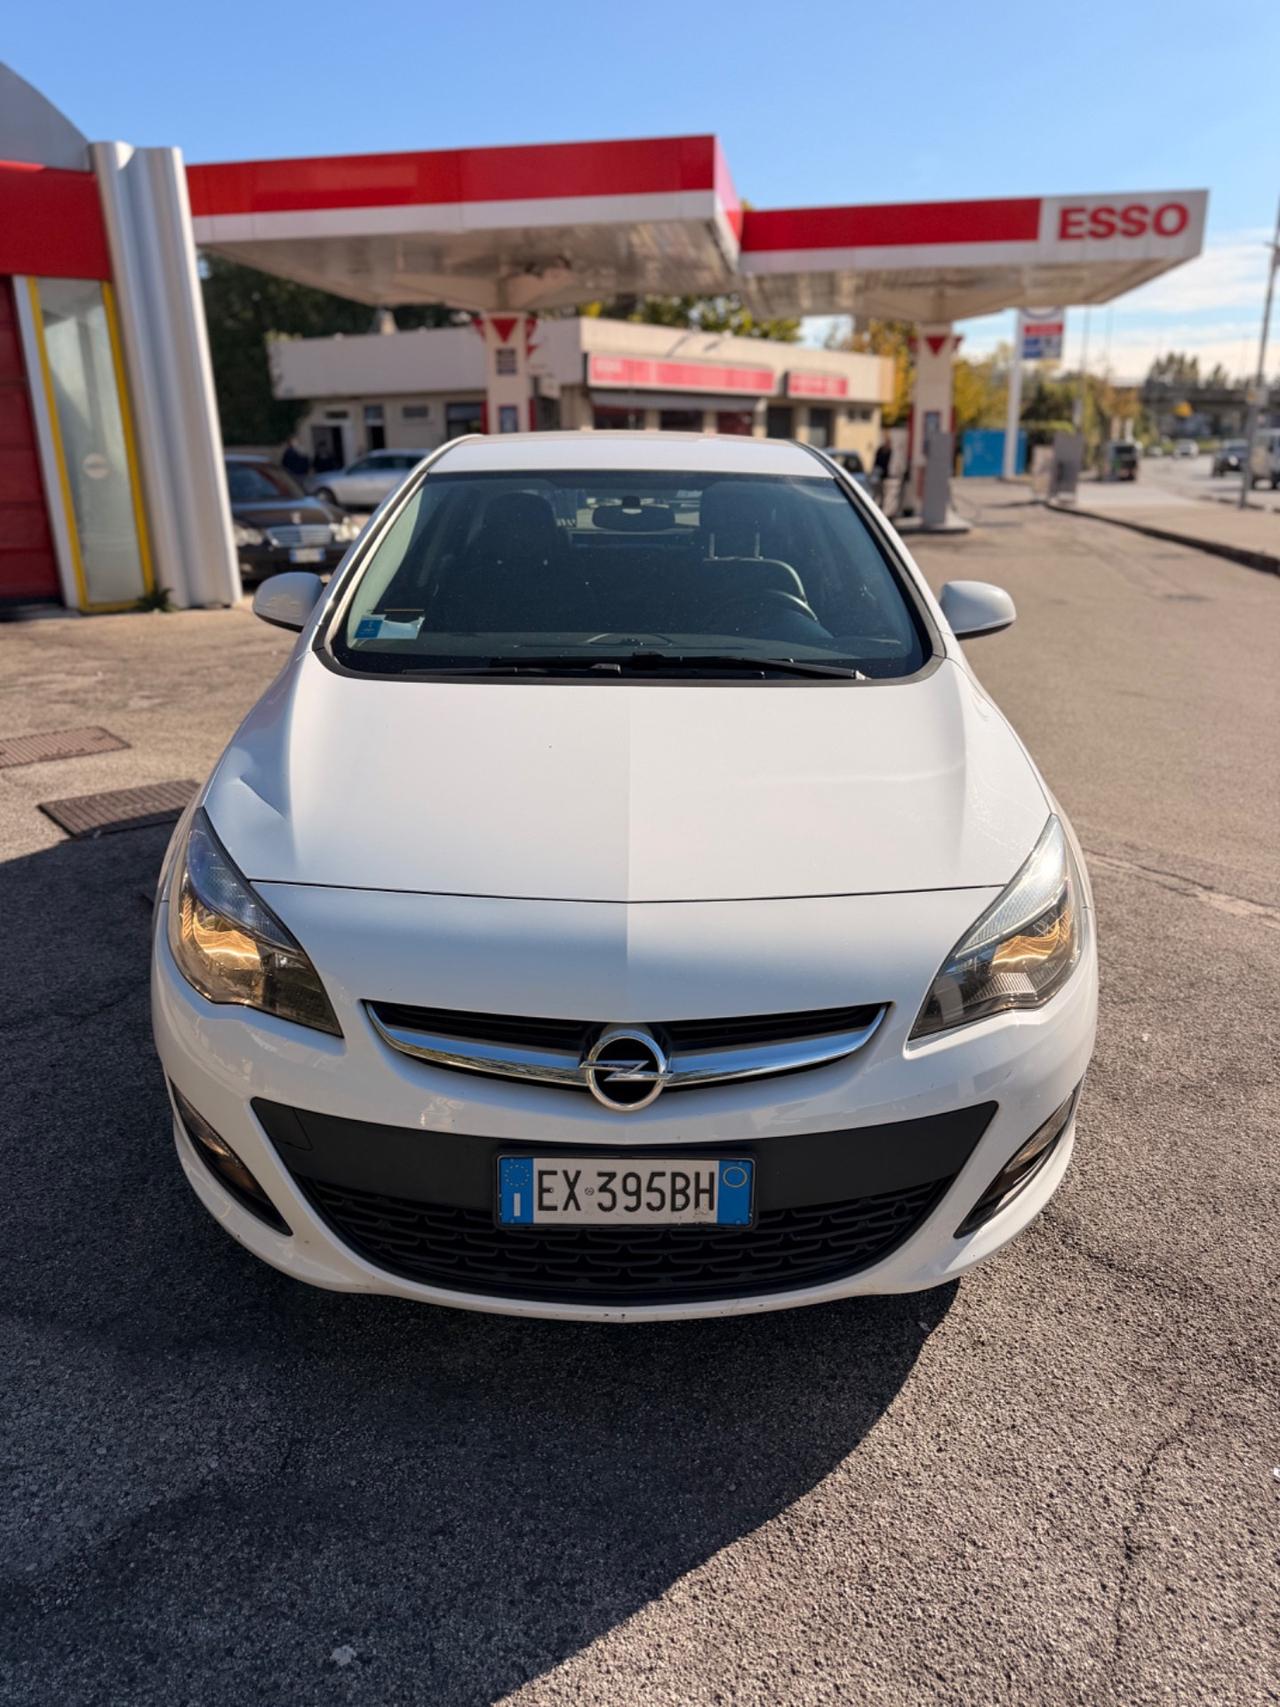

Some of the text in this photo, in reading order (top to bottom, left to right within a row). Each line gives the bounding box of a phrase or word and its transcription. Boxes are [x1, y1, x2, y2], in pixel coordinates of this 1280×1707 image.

[1059, 202, 1189, 241] ESSO
[537, 1170, 715, 1212] EX 395BH
